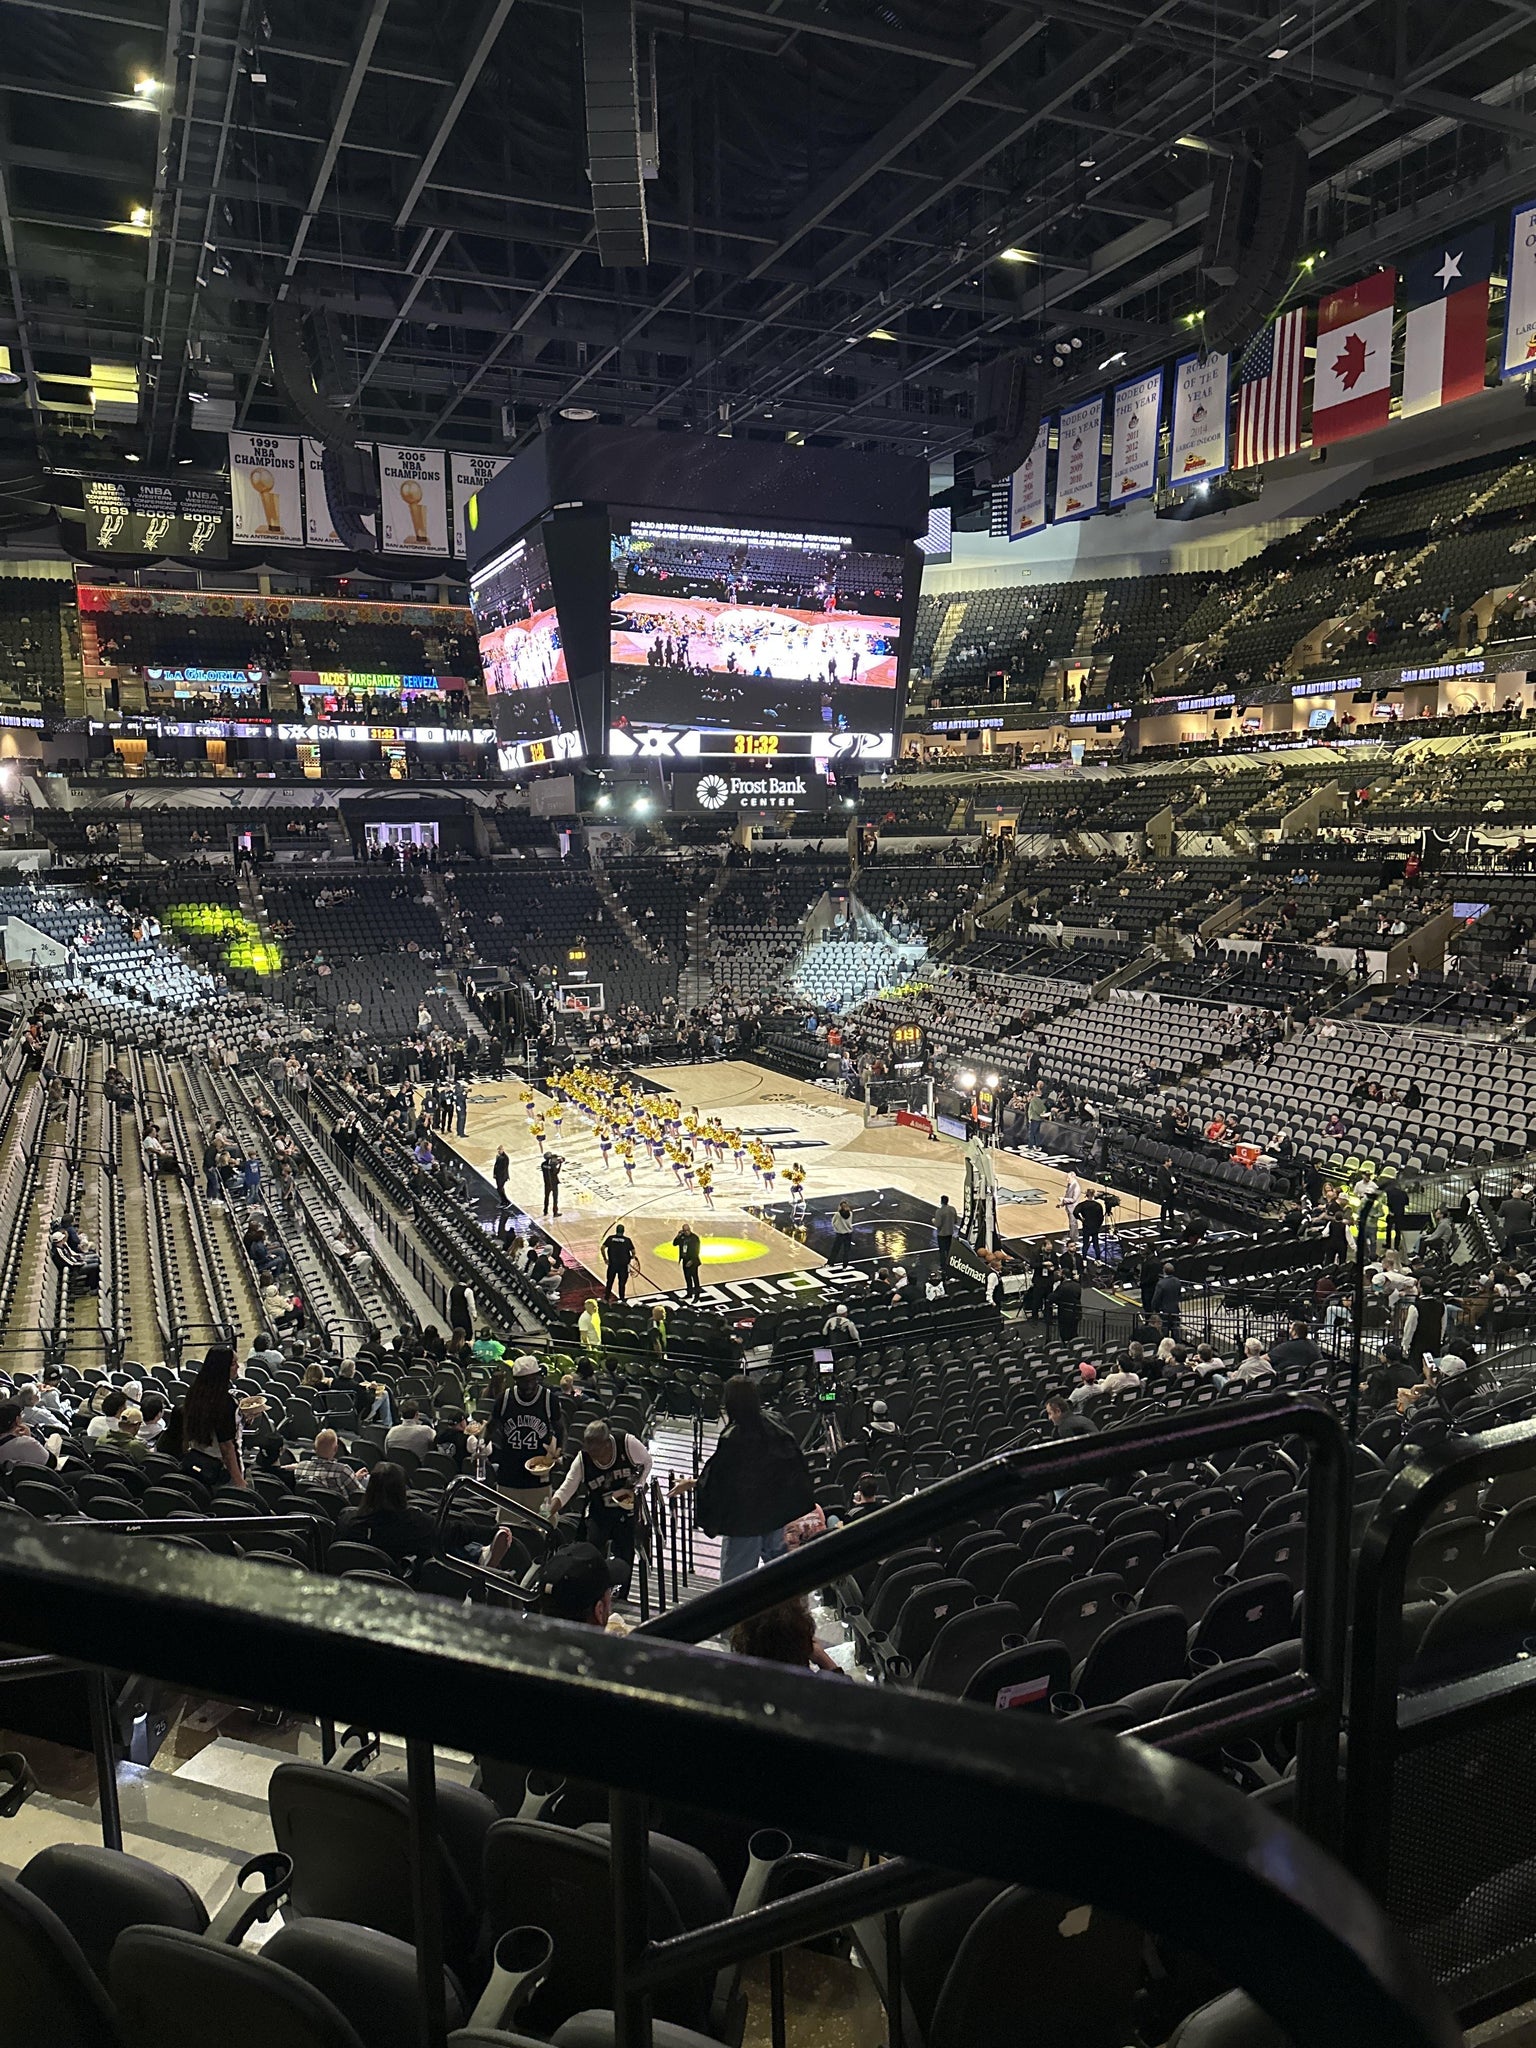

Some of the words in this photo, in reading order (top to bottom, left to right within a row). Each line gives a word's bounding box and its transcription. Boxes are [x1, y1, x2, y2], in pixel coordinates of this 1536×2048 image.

[1183, 377, 1197, 390] OF
[1116, 384, 1145, 404] RODEO
[1147, 377, 1159, 390] OF
[1187, 386, 1213, 403] YEAR
[1089, 403, 1101, 415] OF
[1116, 405, 1132, 417] THE
[1134, 392, 1157, 410] YEAR
[1061, 430, 1076, 440] THE
[1078, 418, 1099, 434] YEAR
[1190, 425, 1208, 438] 2014
[1126, 430, 1139, 442] 2011
[1195, 432, 1221, 447] INDOOR
[249, 437, 279, 449] 1999
[1125, 441, 1139, 453] 2012
[254, 447, 275, 457] NBA
[398, 451, 426, 461] 2005
[234, 454, 295, 469] CHAMPIONS
[470, 458, 497, 469] 2007
[1124, 452, 1138, 465] 2013
[402, 461, 422, 470] NBA
[384, 467, 440, 481] CHAMPIONS
[474, 468, 493, 478] NBA
[457, 474, 491, 486] CHAMP
[91, 489, 126, 497] WESTERN
[97, 482, 126, 492] NBA
[144, 486, 173, 496] NBA
[85, 494, 131, 502] CONFERENCE
[137, 493, 172, 501] WESTERN
[191, 490, 219, 500] NBA
[88, 499, 131, 507] CHAMPIONS
[132, 497, 178, 506] CONFERENCE
[134, 502, 177, 511] CHAMPIONS
[92, 505, 130, 516] 1999
[136, 508, 177, 519] 2003
[183, 512, 222, 523] 2005
[630, 528, 648, 536] YOUR
[648, 529, 678, 539] PRE-GAME
[726, 536, 748, 545] PLEASE
[748, 538, 775, 547] WELCOME
[639, 520, 655, 529] ALSO
[664, 522, 679, 531] PART
[679, 524, 688, 532] OF
[693, 525, 705, 533] FAN
[705, 526, 739, 536] EXPERIENCE
[740, 529, 760, 538] GROUP
[760, 531, 778, 539] SALES
[804, 535, 840, 545] PERFORMING
[840, 538, 852, 546] FOR
[163, 670, 184, 681] LA
[184, 667, 248, 682] GLORIA
[1401, 670, 1418, 682] SAN
[1418, 665, 1454, 681] ANTONIO
[1455, 660, 1485, 675] SPURS
[318, 671, 346, 686] TACOS
[347, 672, 401, 688] MARGARITAS
[403, 674, 439, 689] CERVEZA
[1291, 684, 1306, 696] SAN
[1306, 680, 1336, 694] ANTONIO
[1337, 677, 1362, 690] SPURS
[1178, 700, 1189, 711] SAN
[1189, 697, 1215, 709] ANTONIO
[1215, 694, 1236, 705] SPURS
[1070, 712, 1086, 723] SAN
[1087, 710, 1114, 722] ANTONIO
[1115, 708, 1132, 720] SPURS
[0, 716, 20, 727] TONIO
[22, 716, 45, 729] SPURS
[932, 721, 947, 731] SAN
[948, 719, 979, 730] ANTONIO
[980, 717, 1004, 728] SPURS
[164, 725, 179, 736] TO
[318, 727, 338, 740] SA
[370, 729, 395, 739] 31:32
[446, 730, 472, 742] MIA
[733, 734, 780, 754] 31:32
[730, 776, 767, 794] Frost
[769, 775, 807, 794] Bank
[740, 797, 796, 807] CENTER
[508, 1430, 538, 1450] 44
